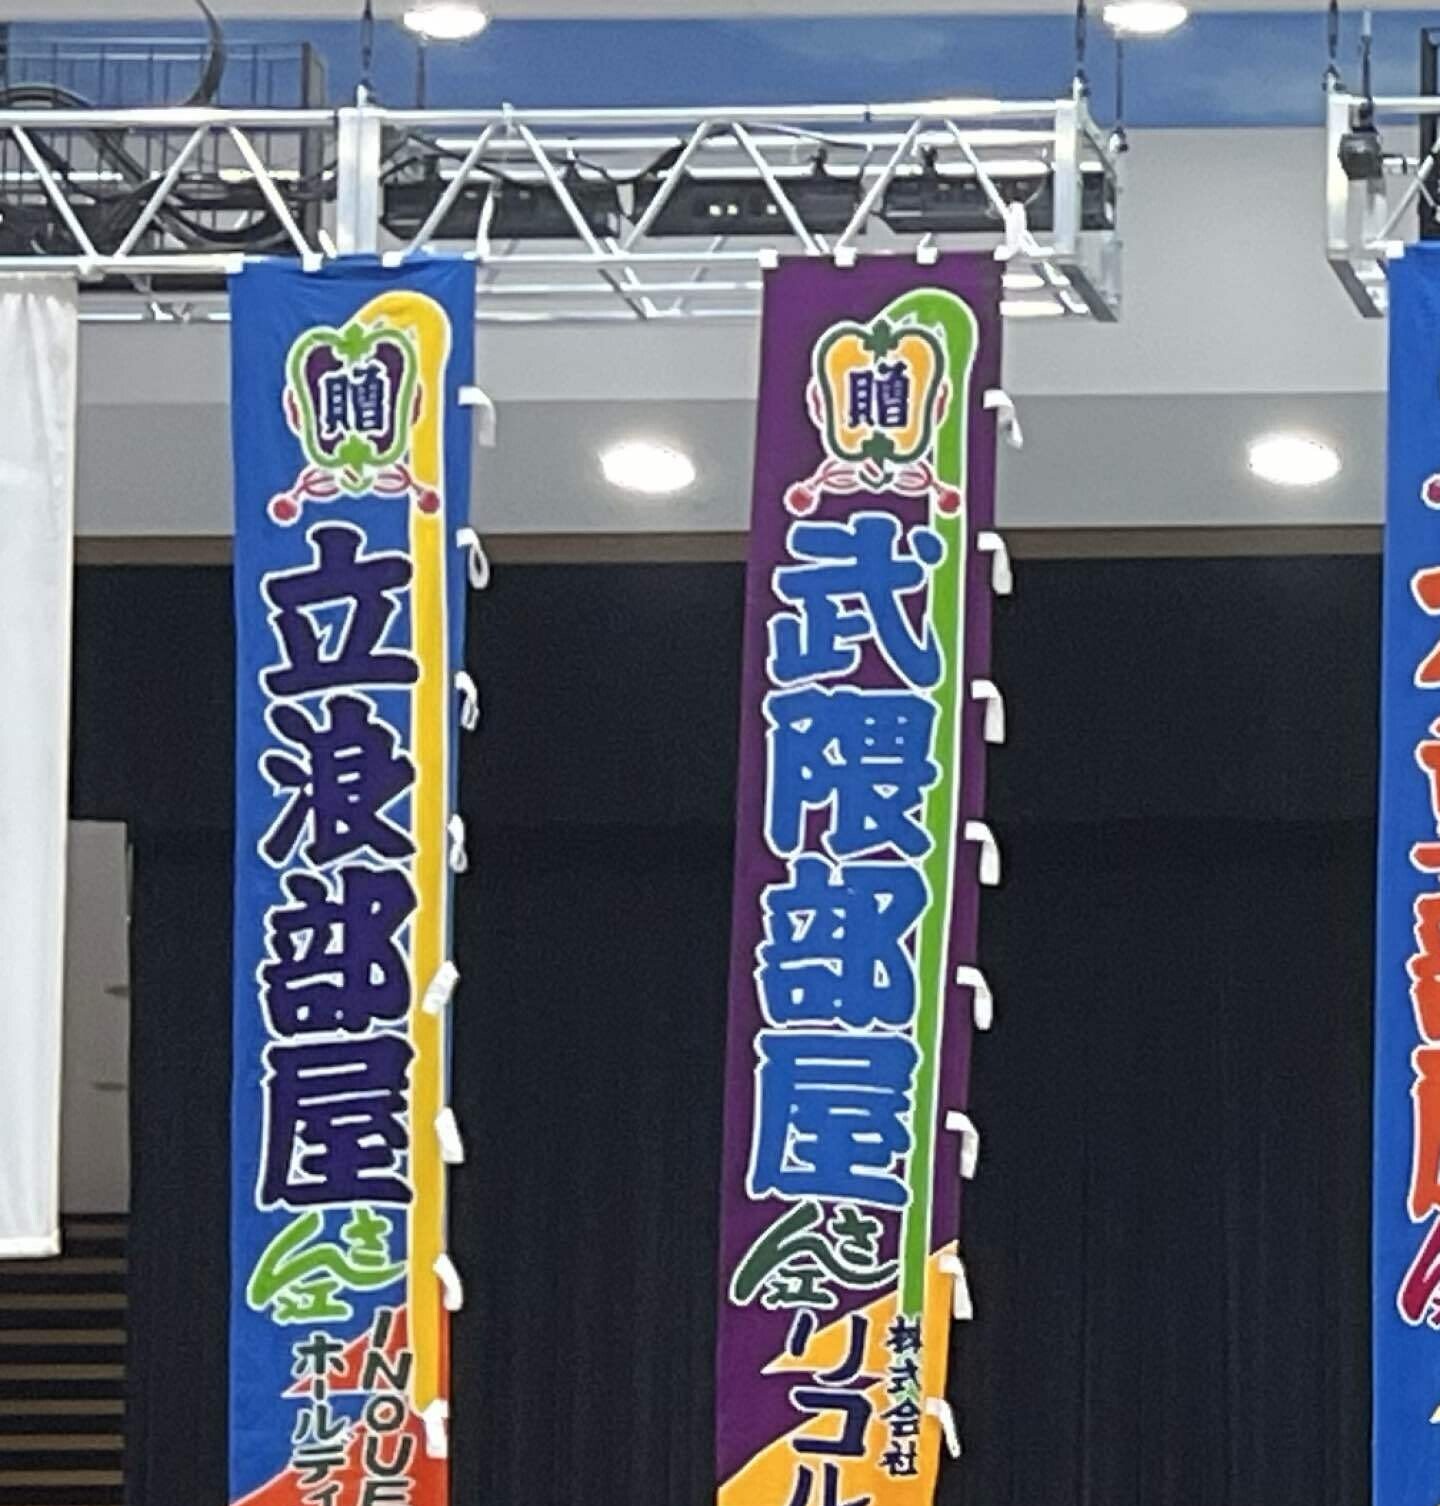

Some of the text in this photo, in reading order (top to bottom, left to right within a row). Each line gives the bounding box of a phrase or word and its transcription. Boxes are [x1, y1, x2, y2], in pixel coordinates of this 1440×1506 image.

[324, 362, 386, 433] 贈
[844, 359, 913, 431] 贈
[258, 526, 419, 1207] 立浪部屋
[748, 515, 945, 1209] 武隈部屋
[882, 1315, 922, 1476] 株式会社
